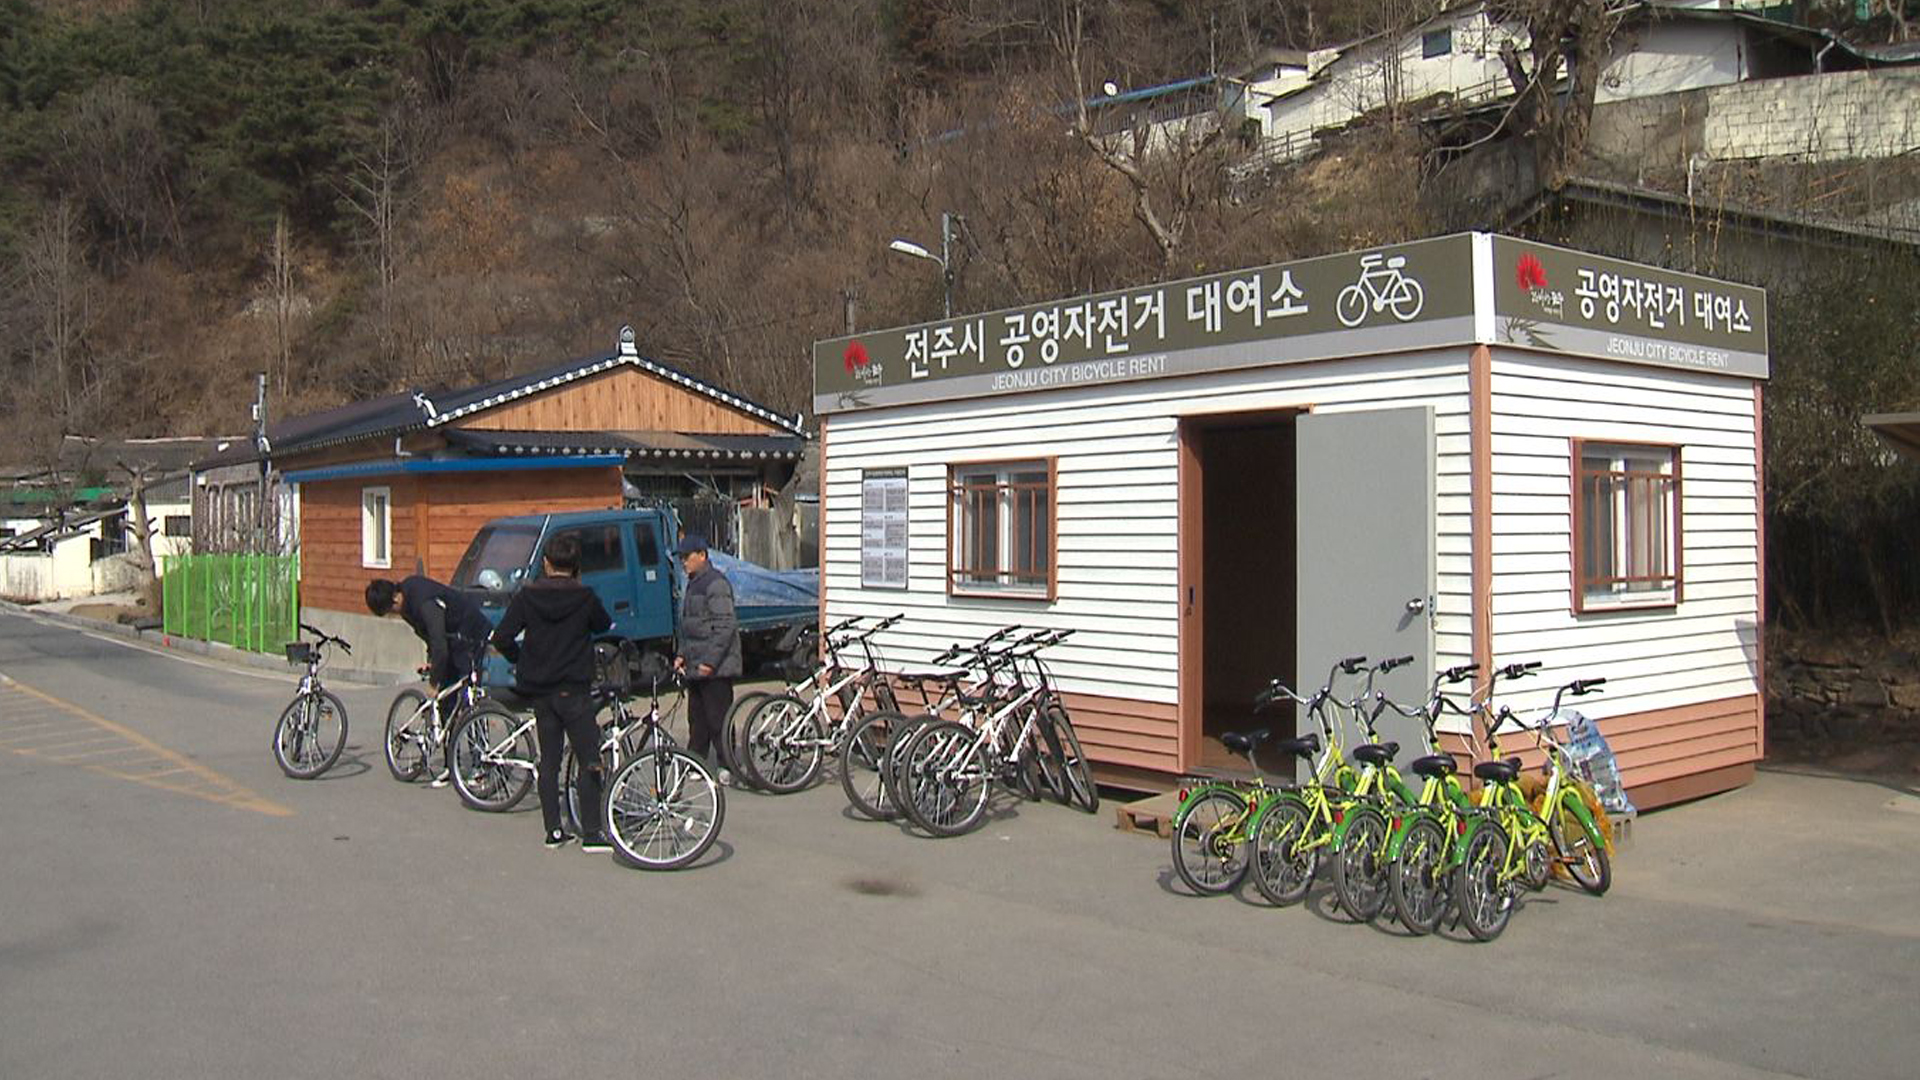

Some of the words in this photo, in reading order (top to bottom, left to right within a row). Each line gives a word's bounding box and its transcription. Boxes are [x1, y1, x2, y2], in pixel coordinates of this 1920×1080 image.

[904, 319, 984, 379] 전주시
[1000, 290, 1165, 368] 공영자전거
[1187, 270, 1309, 332] 대여소
[1575, 269, 1685, 329] 공영자전거
[1694, 291, 1752, 333] 대여소
[991, 371, 1038, 390] JEONJU
[1040, 365, 1069, 384] CITY
[1071, 358, 1126, 381] BICYCLE
[1129, 355, 1168, 375] RENT
[1606, 337, 1645, 357] JEONJU
[1645, 343, 1667, 360] CITY
[1668, 346, 1706, 365] BICYCLE
[1706, 351, 1730, 367] RENT
